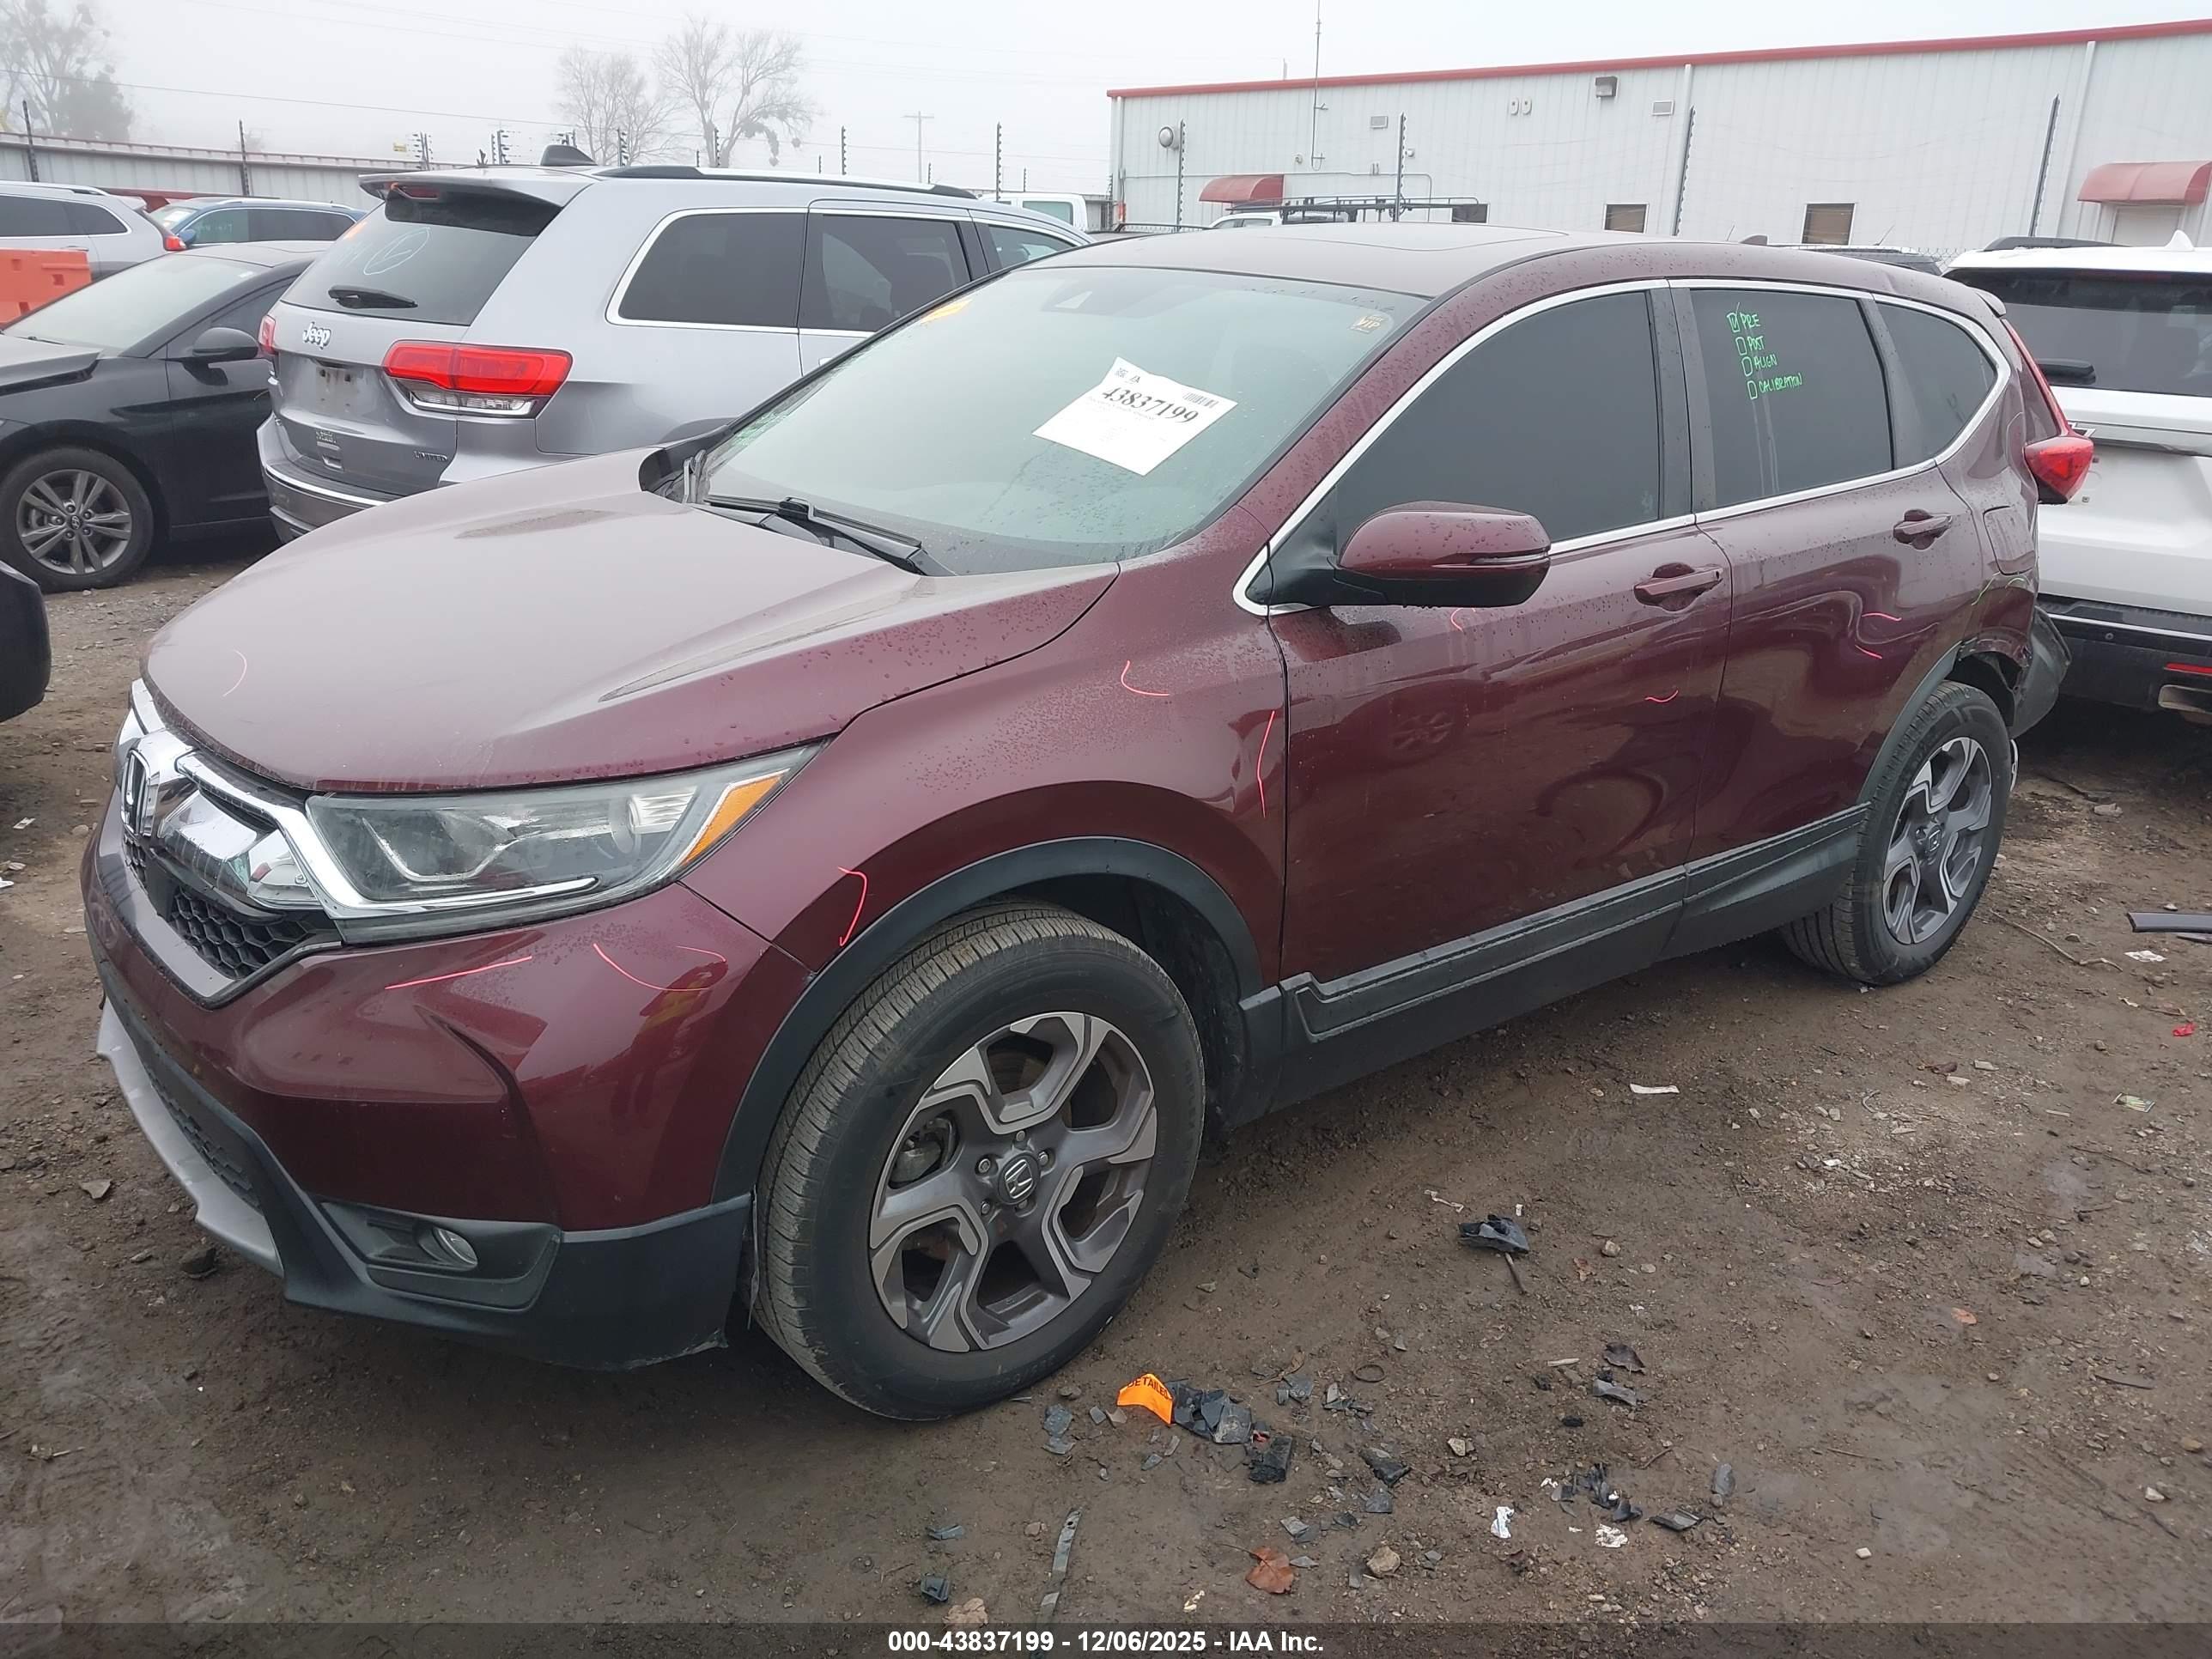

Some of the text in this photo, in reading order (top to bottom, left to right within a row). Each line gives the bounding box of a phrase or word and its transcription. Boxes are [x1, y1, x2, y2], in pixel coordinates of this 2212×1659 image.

[1739, 312, 1761, 330] PRE
[302, 321, 331, 349] Jeep
[1747, 335, 1765, 351] POST
[1753, 353, 1778, 369] ALIGN
[1759, 372, 1802, 393] CALIBRATION
[1102, 386, 1200, 423] 43837199
